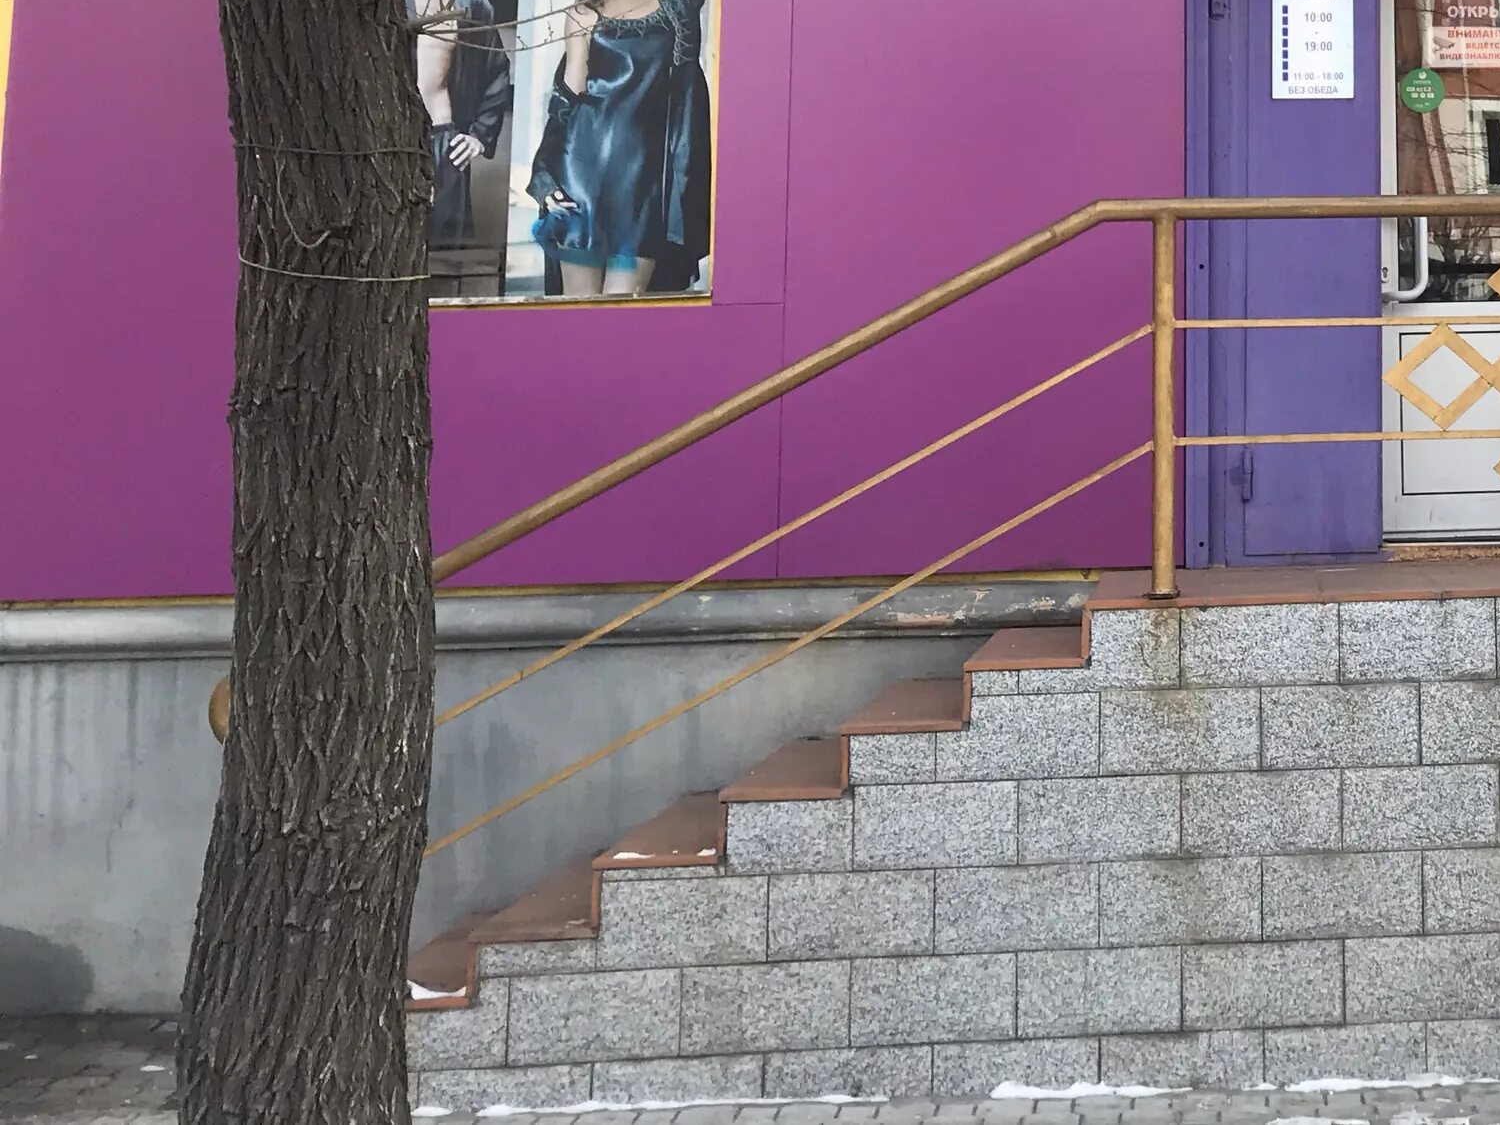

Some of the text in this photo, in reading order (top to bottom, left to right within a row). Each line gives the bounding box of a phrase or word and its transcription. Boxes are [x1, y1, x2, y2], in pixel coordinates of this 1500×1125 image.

[1304, 12, 1334, 23] 10:00
[1304, 41, 1334, 52] 19:00
[1293, 72, 1315, 81] 11:00
[1288, 86, 1339, 96] БЕЗ ОБЕДА
